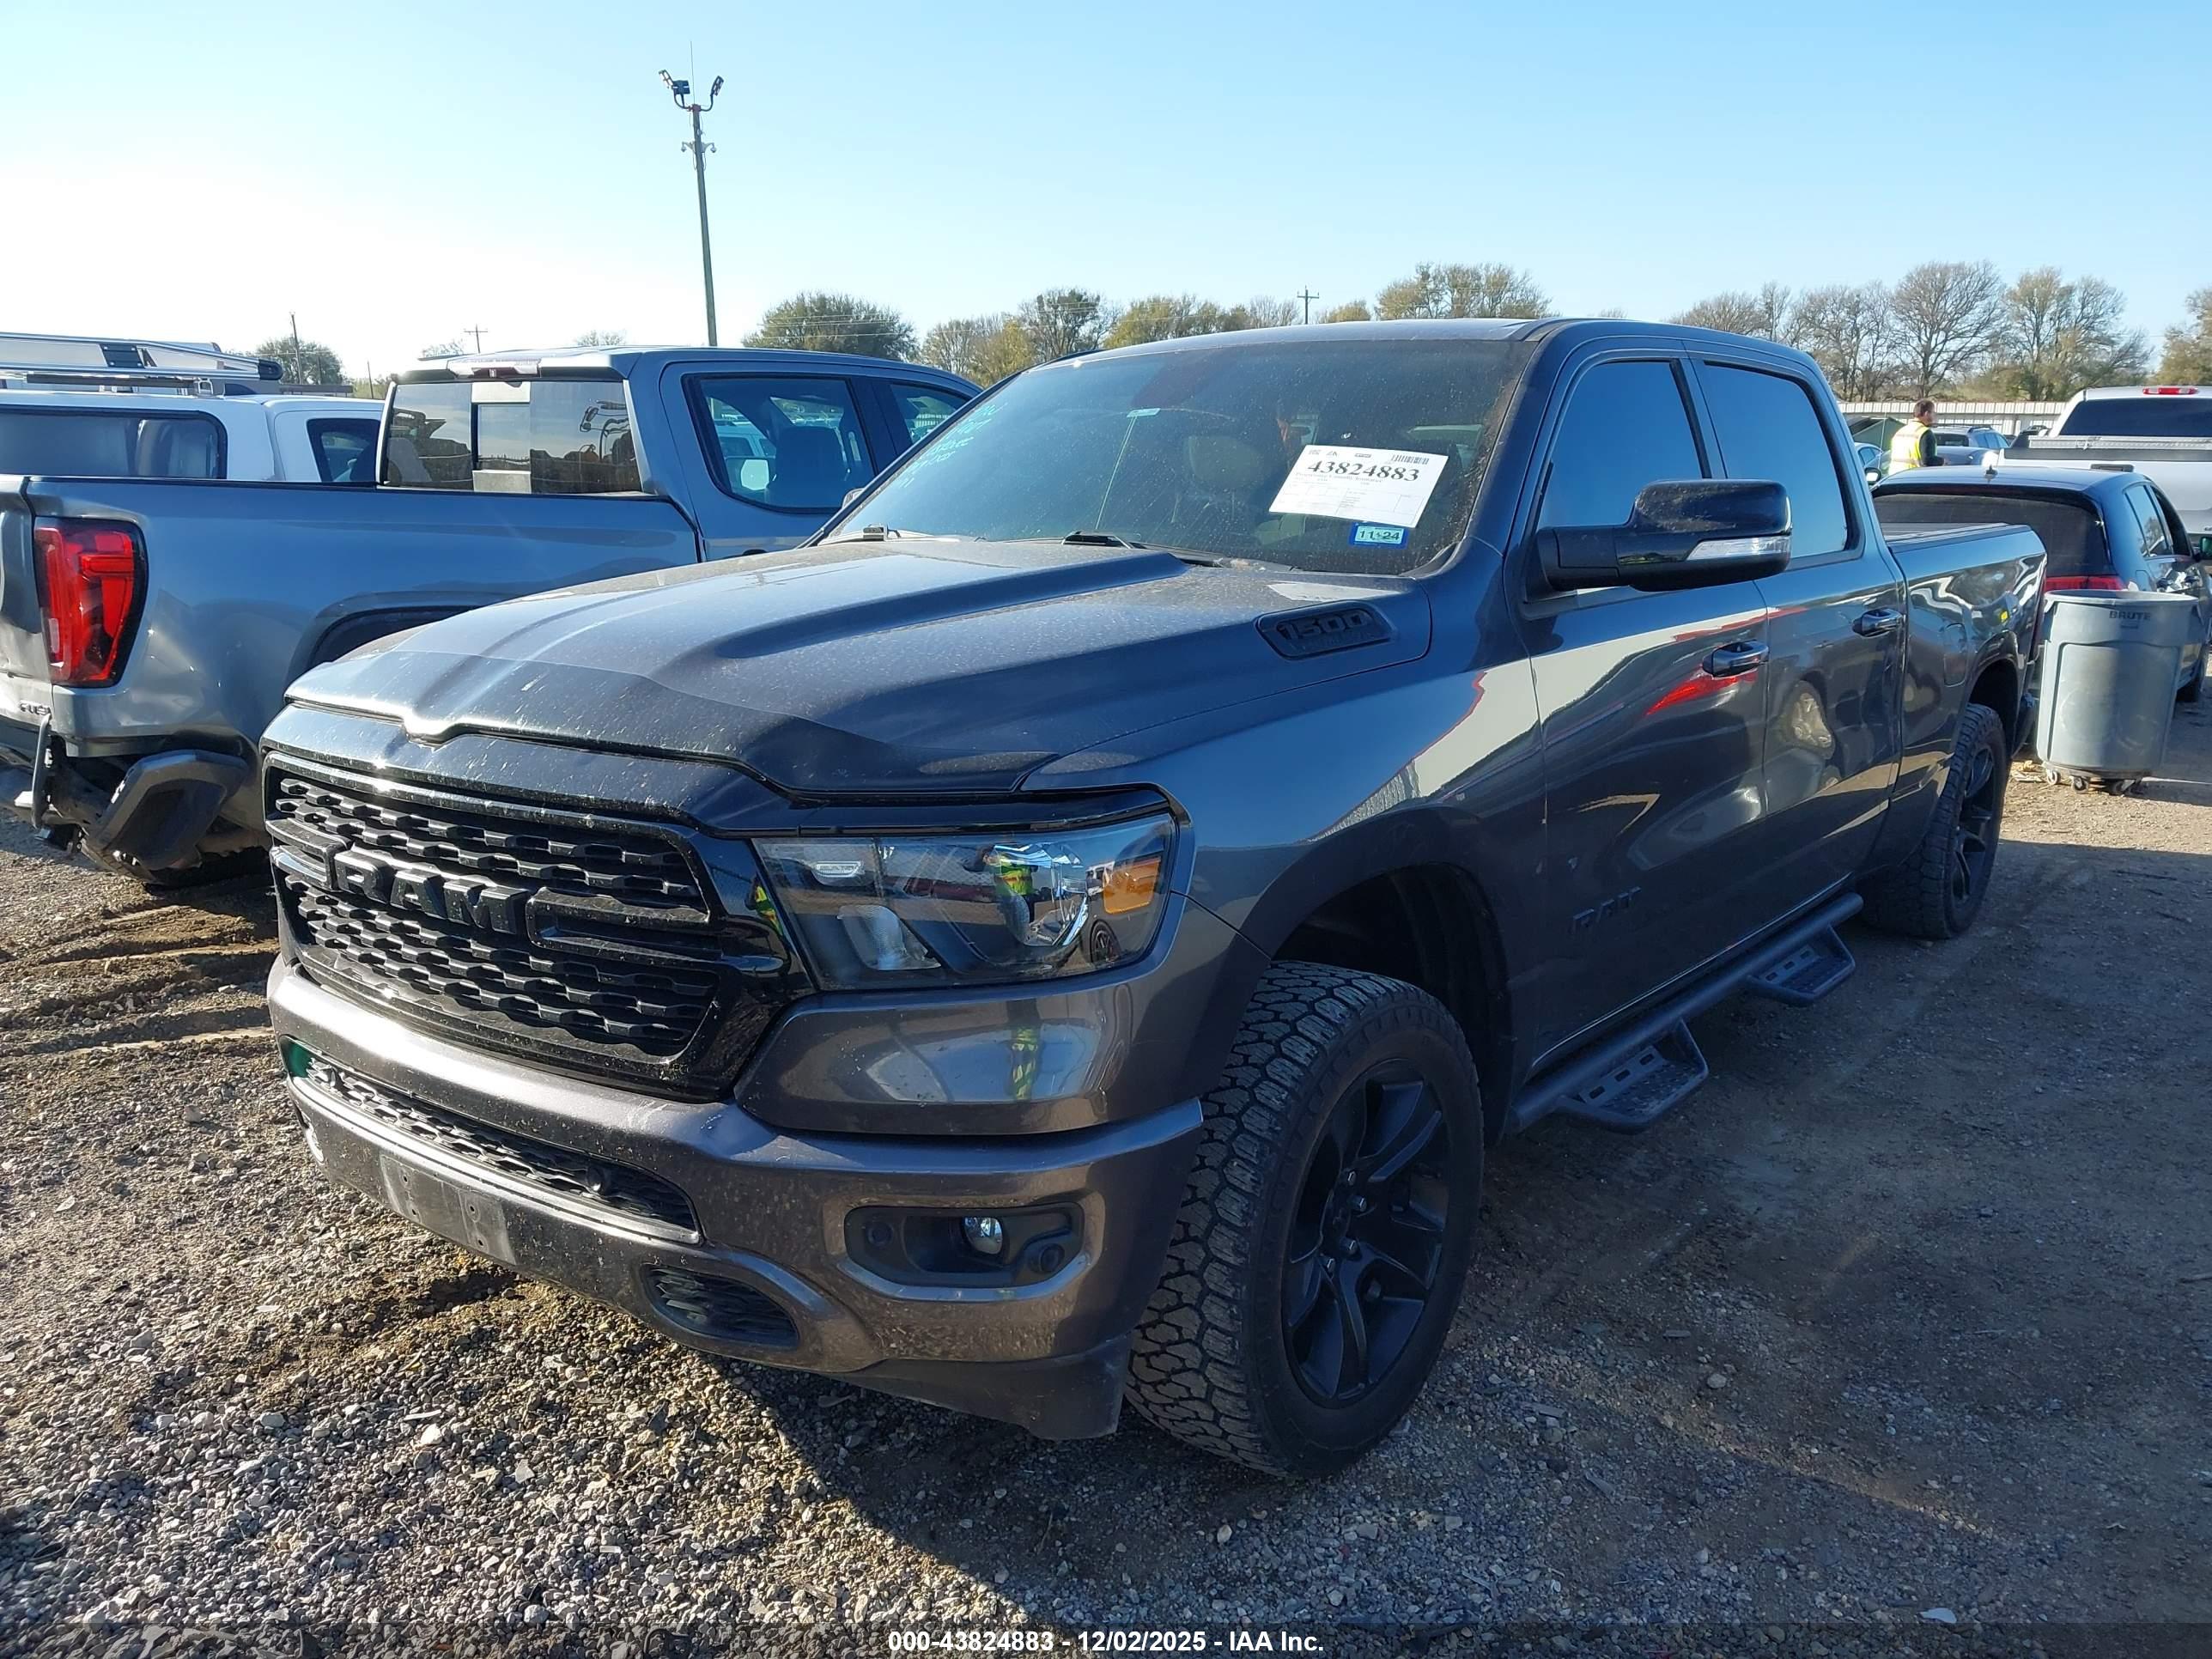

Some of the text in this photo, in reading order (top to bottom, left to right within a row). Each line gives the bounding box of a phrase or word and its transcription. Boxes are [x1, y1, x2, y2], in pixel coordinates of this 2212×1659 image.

[1307, 459, 1420, 482] 43824883
[1277, 611, 1370, 640] 1500
[2109, 611, 2151, 621] BRUTE
[332, 843, 532, 933] RAM
